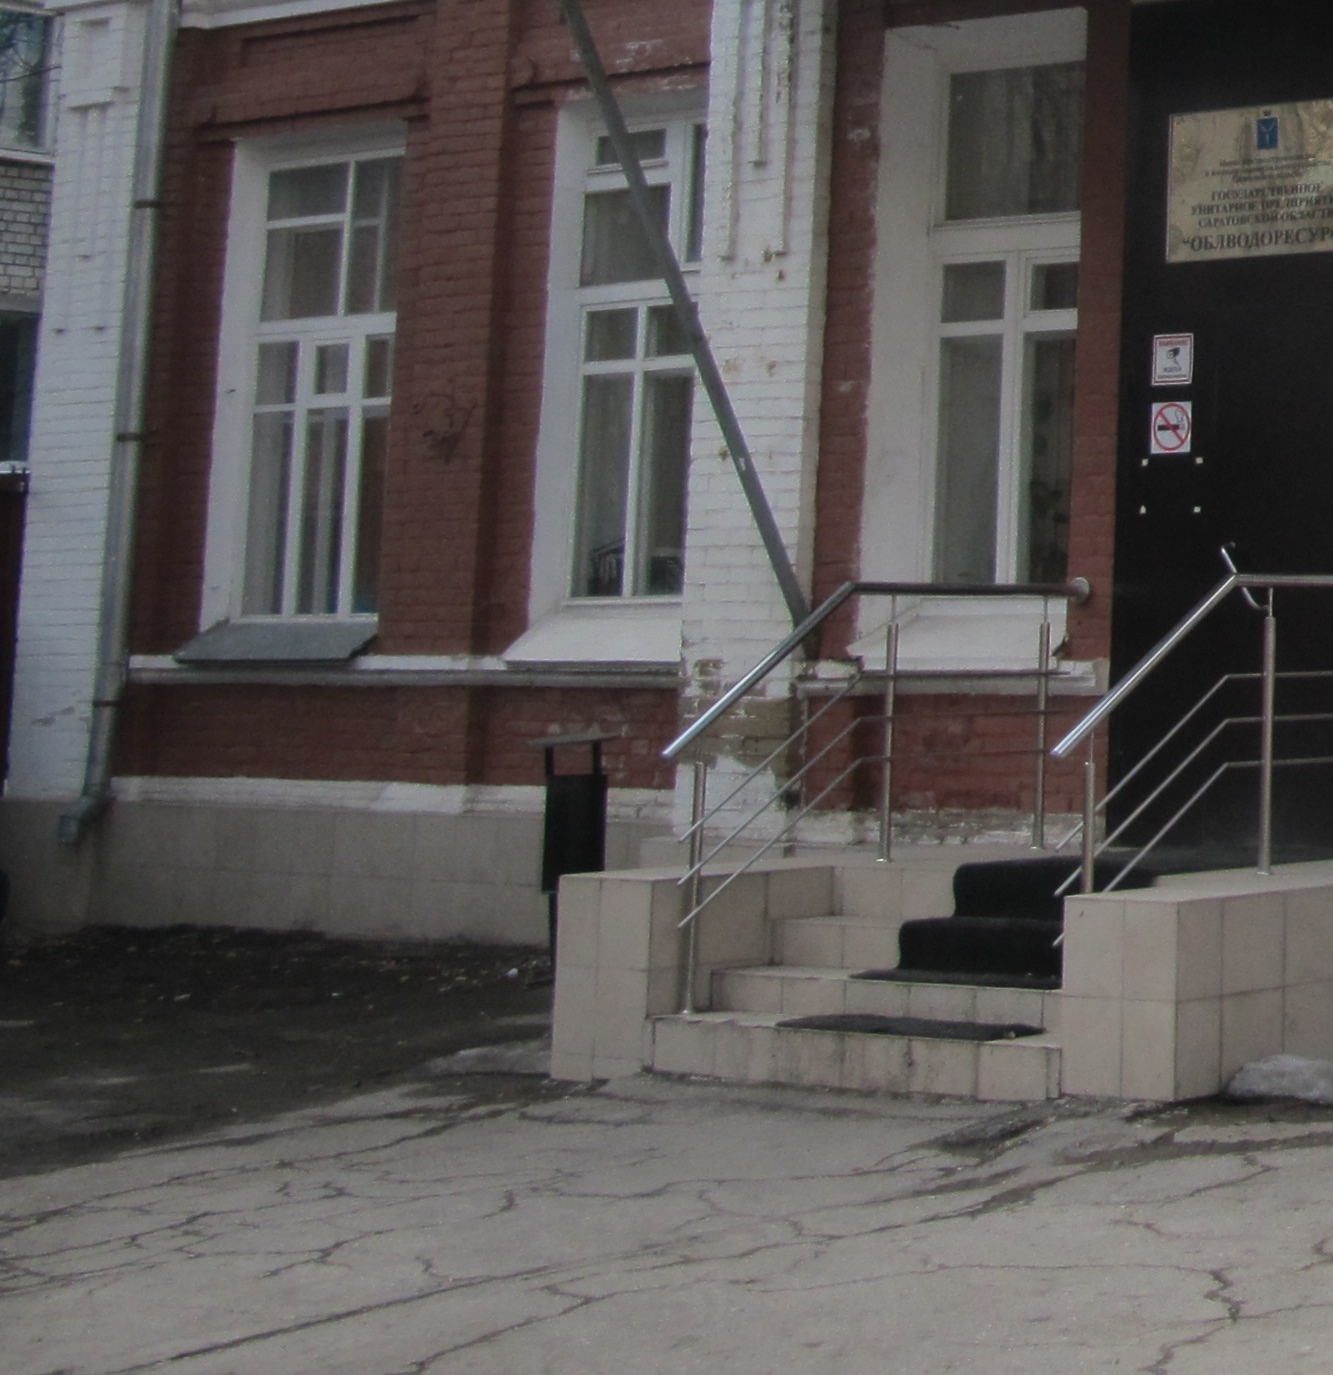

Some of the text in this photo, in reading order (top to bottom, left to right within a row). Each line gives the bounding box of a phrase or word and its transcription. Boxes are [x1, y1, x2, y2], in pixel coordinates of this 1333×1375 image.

[1211, 184, 1322, 201] ГОСУДАРСТВЕННОЕ
[1192, 200, 1256, 215] УНИТАРНОЕ
[1198, 212, 1278, 227] САРАТОВСКОЙ
